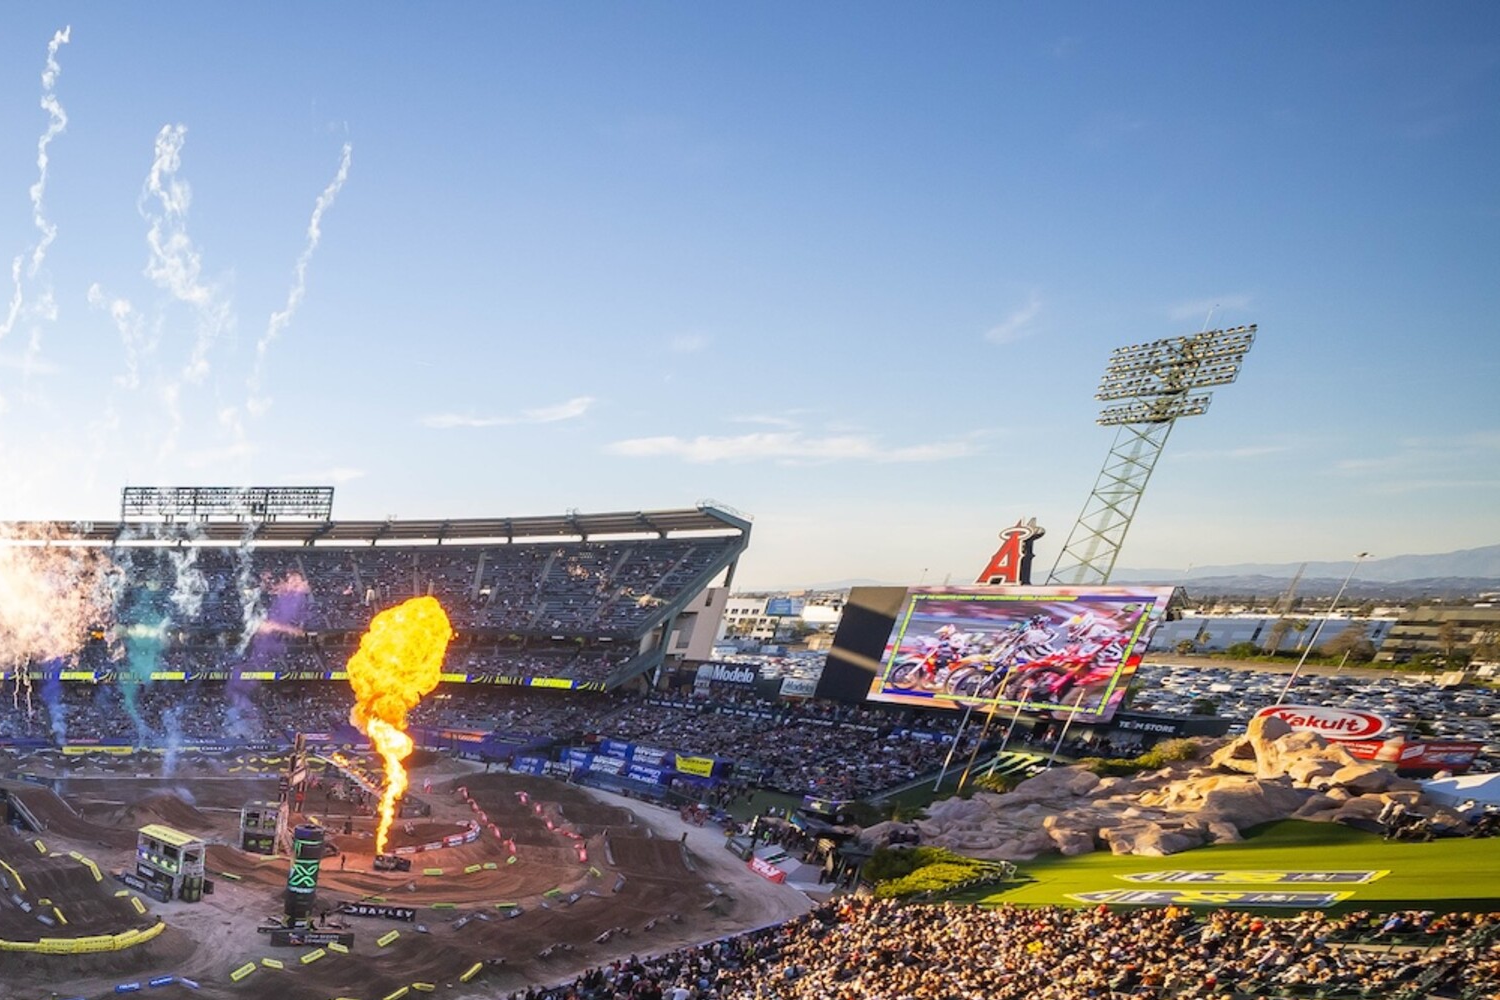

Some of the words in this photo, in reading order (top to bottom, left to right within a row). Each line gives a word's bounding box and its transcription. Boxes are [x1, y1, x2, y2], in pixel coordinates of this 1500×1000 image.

[712, 665, 755, 683] Modelo
[784, 679, 816, 694] Modelo
[1144, 722, 1176, 733] STORE
[1278, 711, 1362, 733] Yakult
[359, 907, 413, 918] OAKLEY
